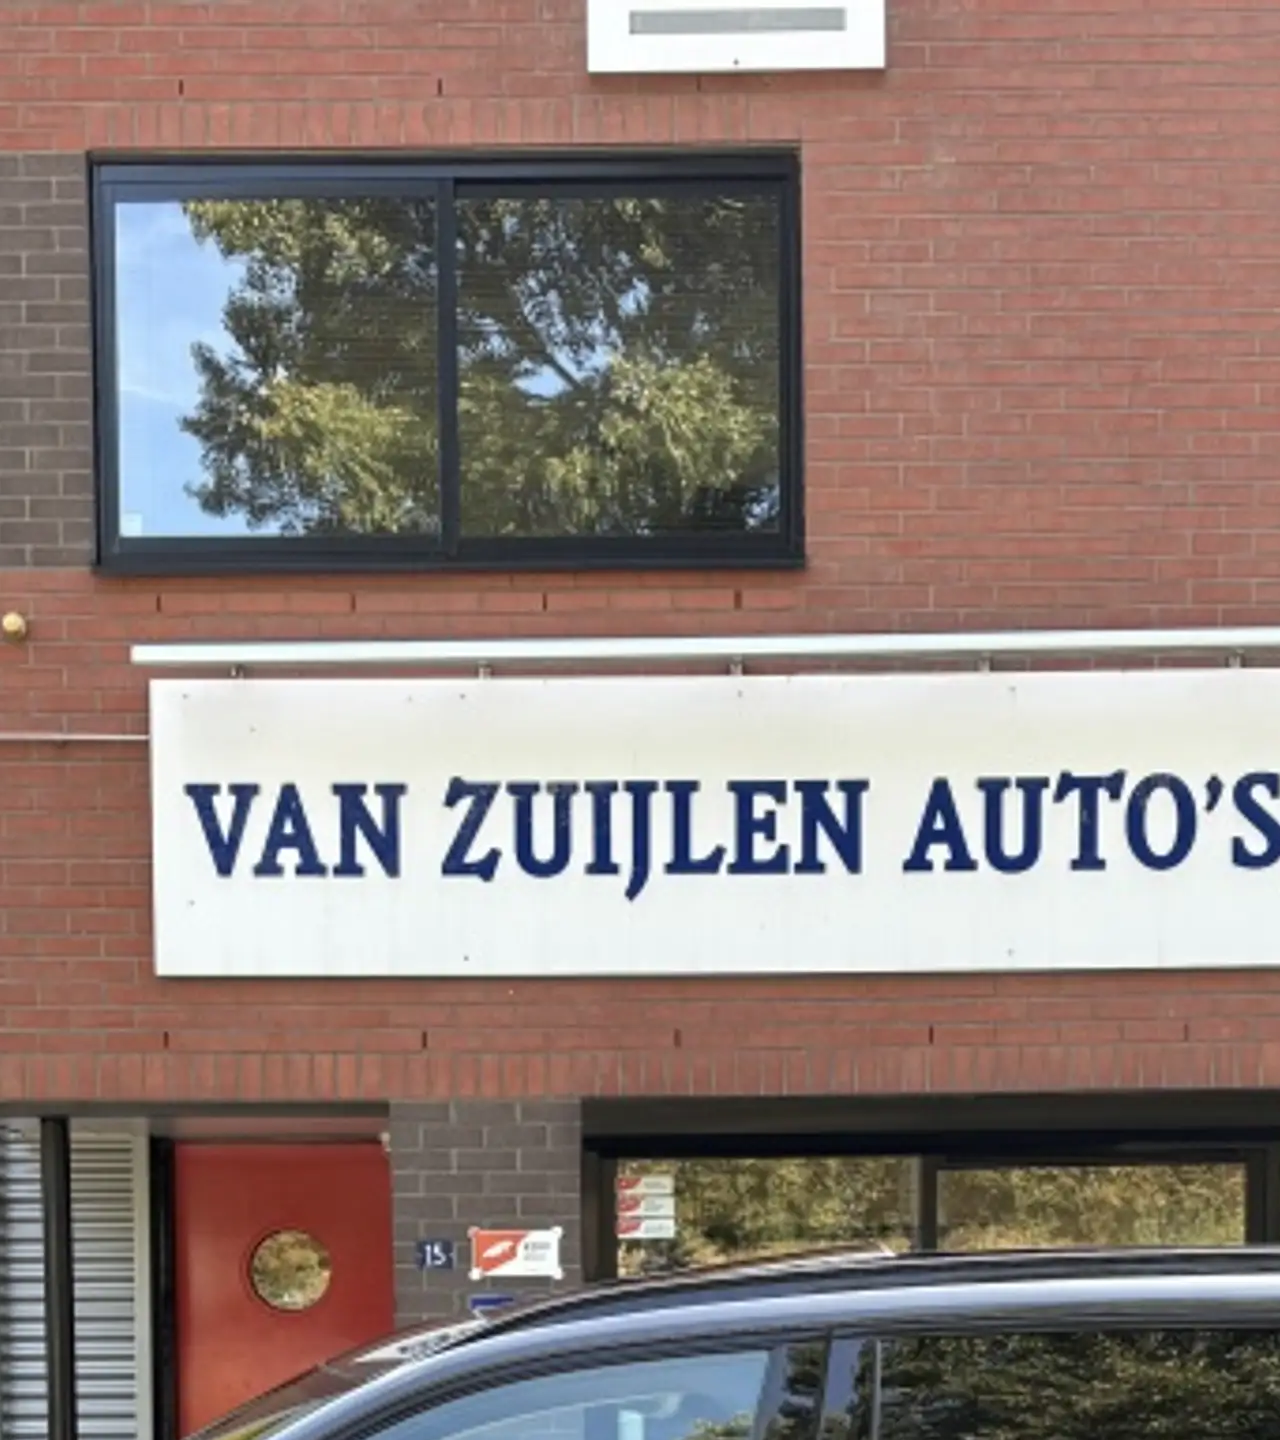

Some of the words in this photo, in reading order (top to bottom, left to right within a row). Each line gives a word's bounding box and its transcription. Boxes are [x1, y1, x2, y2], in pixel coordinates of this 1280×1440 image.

[184, 783, 409, 880] VAN
[441, 776, 872, 903] ZUIJLEN
[424, 1243, 447, 1268] 15
